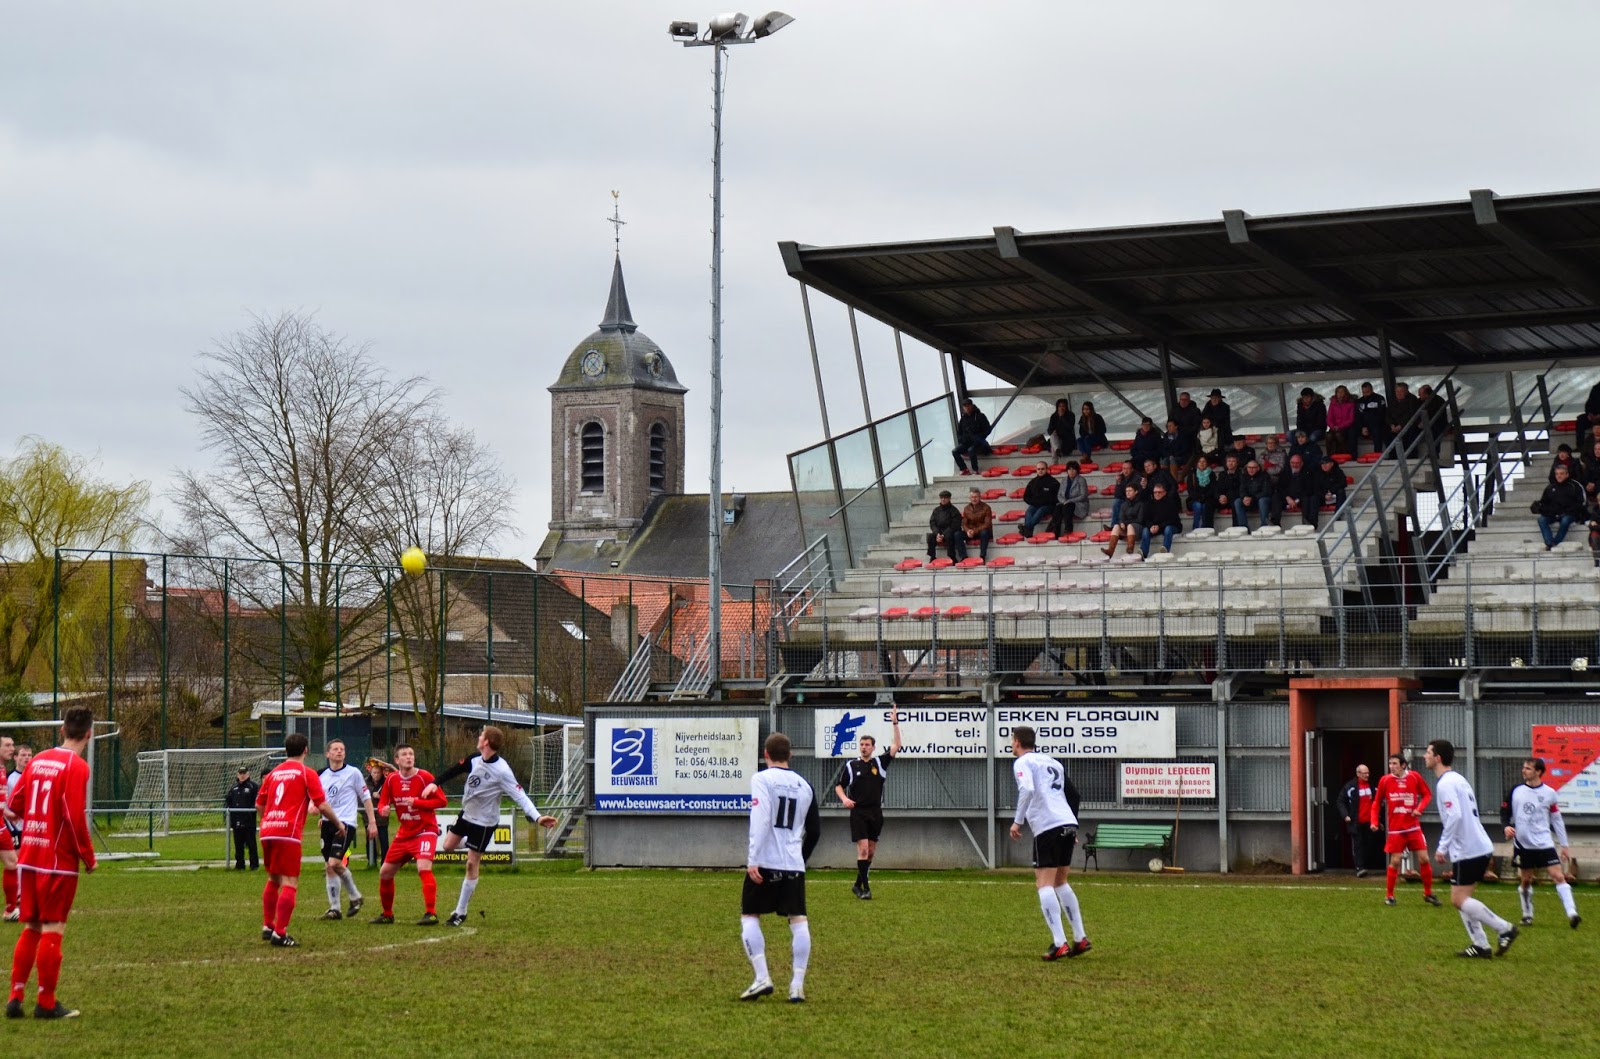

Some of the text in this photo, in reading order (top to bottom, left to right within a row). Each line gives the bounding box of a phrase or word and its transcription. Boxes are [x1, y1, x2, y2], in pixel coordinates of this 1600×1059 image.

[1066, 710, 1159, 721] FLORQUIN
[675, 732, 743, 743] Nijverheidslaan 3
[955, 726, 1117, 738] tel: 0/500 359
[675, 745, 710, 756] Ledegem
[675, 757, 739, 766] Tel: 056/43.18.43
[675, 769, 742, 779] Fax: 056/41.28.48
[1125, 766, 1210, 775] Olympic LEDEGEM
[611, 776, 658, 786] BEEUWSAERT
[1046, 765, 1062, 791] 2
[28, 779, 53, 815] 17
[274, 781, 285, 806] 9
[599, 797, 752, 810] www.beeuwsaert-construct.be
[774, 796, 798, 831] 11
[420, 840, 431, 852] 19
[480, 853, 510, 861] NKSHOPS
